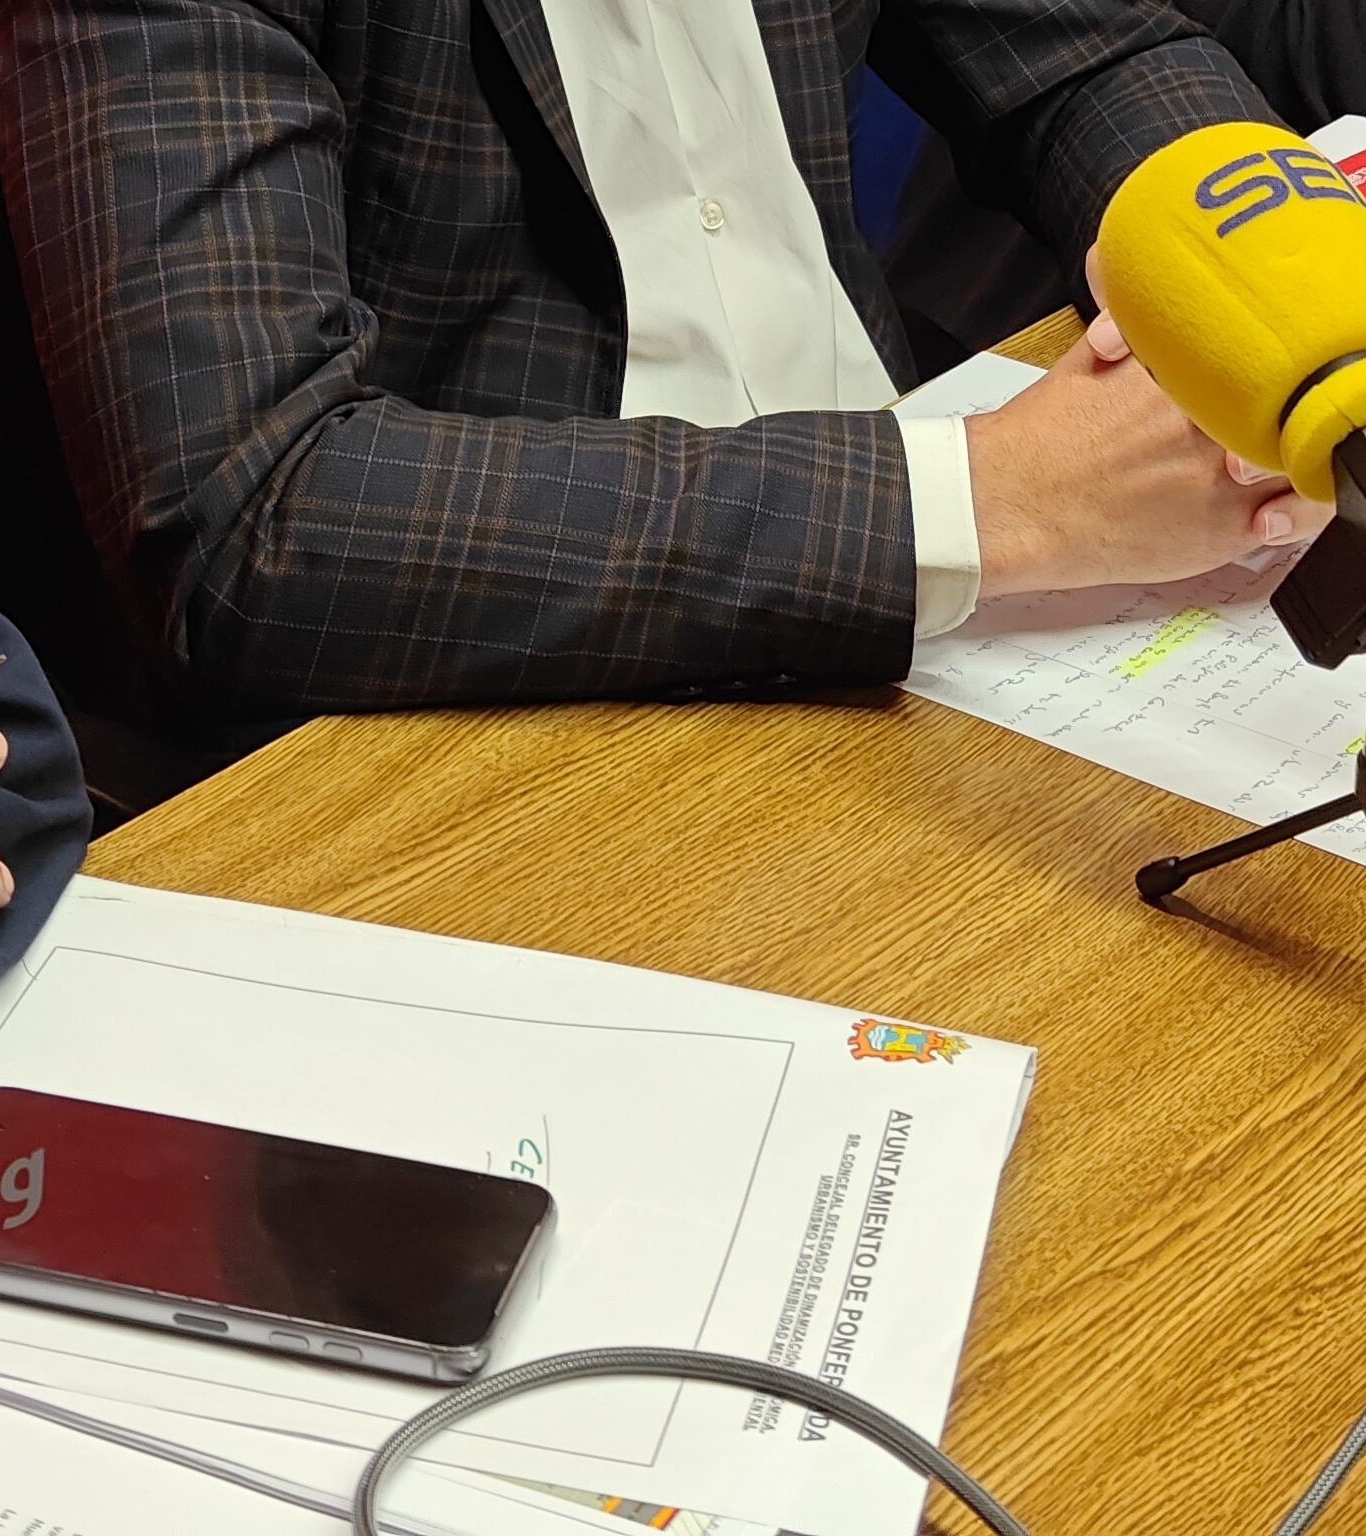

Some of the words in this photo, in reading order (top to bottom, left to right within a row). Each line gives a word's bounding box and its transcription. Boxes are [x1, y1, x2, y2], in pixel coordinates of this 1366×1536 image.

[844, 1134, 861, 1152] SR.
[804, 1176, 833, 1241] URBANISMO
[828, 1153, 855, 1211] CONCEJAL
[854, 1110, 913, 1267] AYUNTAMIENTO
[800, 1241, 815, 1252] Y
[811, 1212, 840, 1273] DELEGADO
[773, 1253, 813, 1339] SOSTENIBILIDAD
[805, 1275, 823, 1292] DE
[844, 1273, 872, 1302] DE
[780, 1292, 818, 1368] DINAMIZACIÓN
[801, 1306, 862, 1441] PONFERDA
